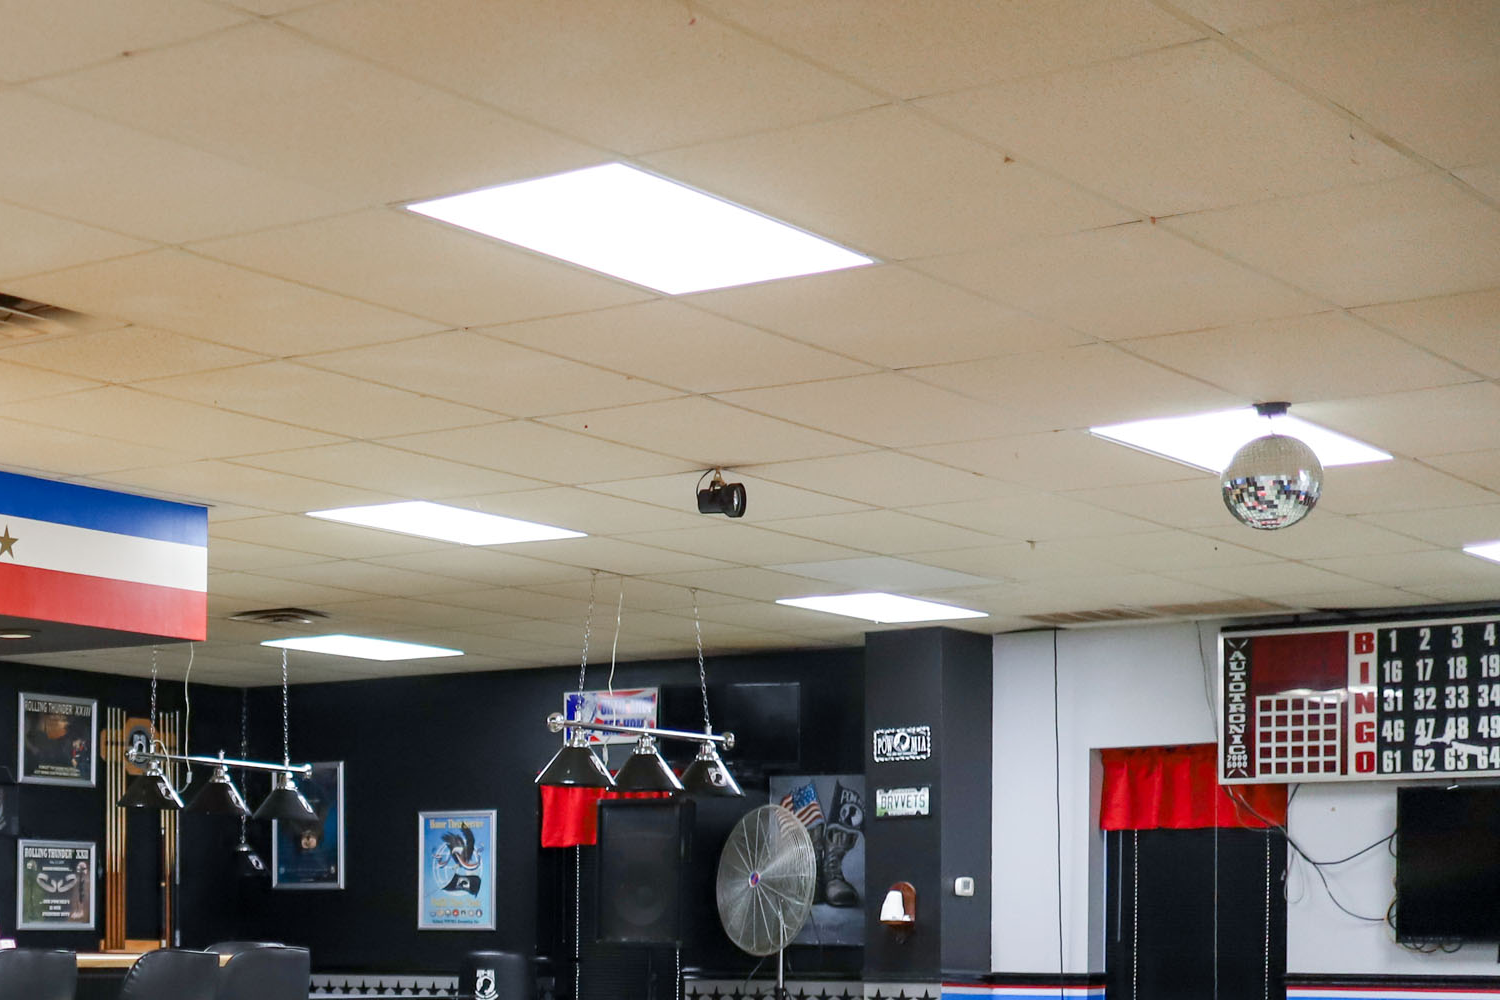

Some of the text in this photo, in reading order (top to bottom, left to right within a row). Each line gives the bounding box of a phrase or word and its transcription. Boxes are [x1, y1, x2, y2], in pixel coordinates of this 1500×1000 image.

[1389, 623, 1496, 652] 1 2 3 4
[1383, 654, 1500, 683] 16 17 18 19
[1228, 650, 1247, 755] AUTOTRONIC
[1354, 632, 1376, 773] BINGO
[1383, 684, 1500, 712] 31 32 33 34
[1382, 715, 1500, 742] 46 47 48 49
[877, 735, 927, 755] POW MIA
[1382, 746, 1500, 773] 61 62 63 64
